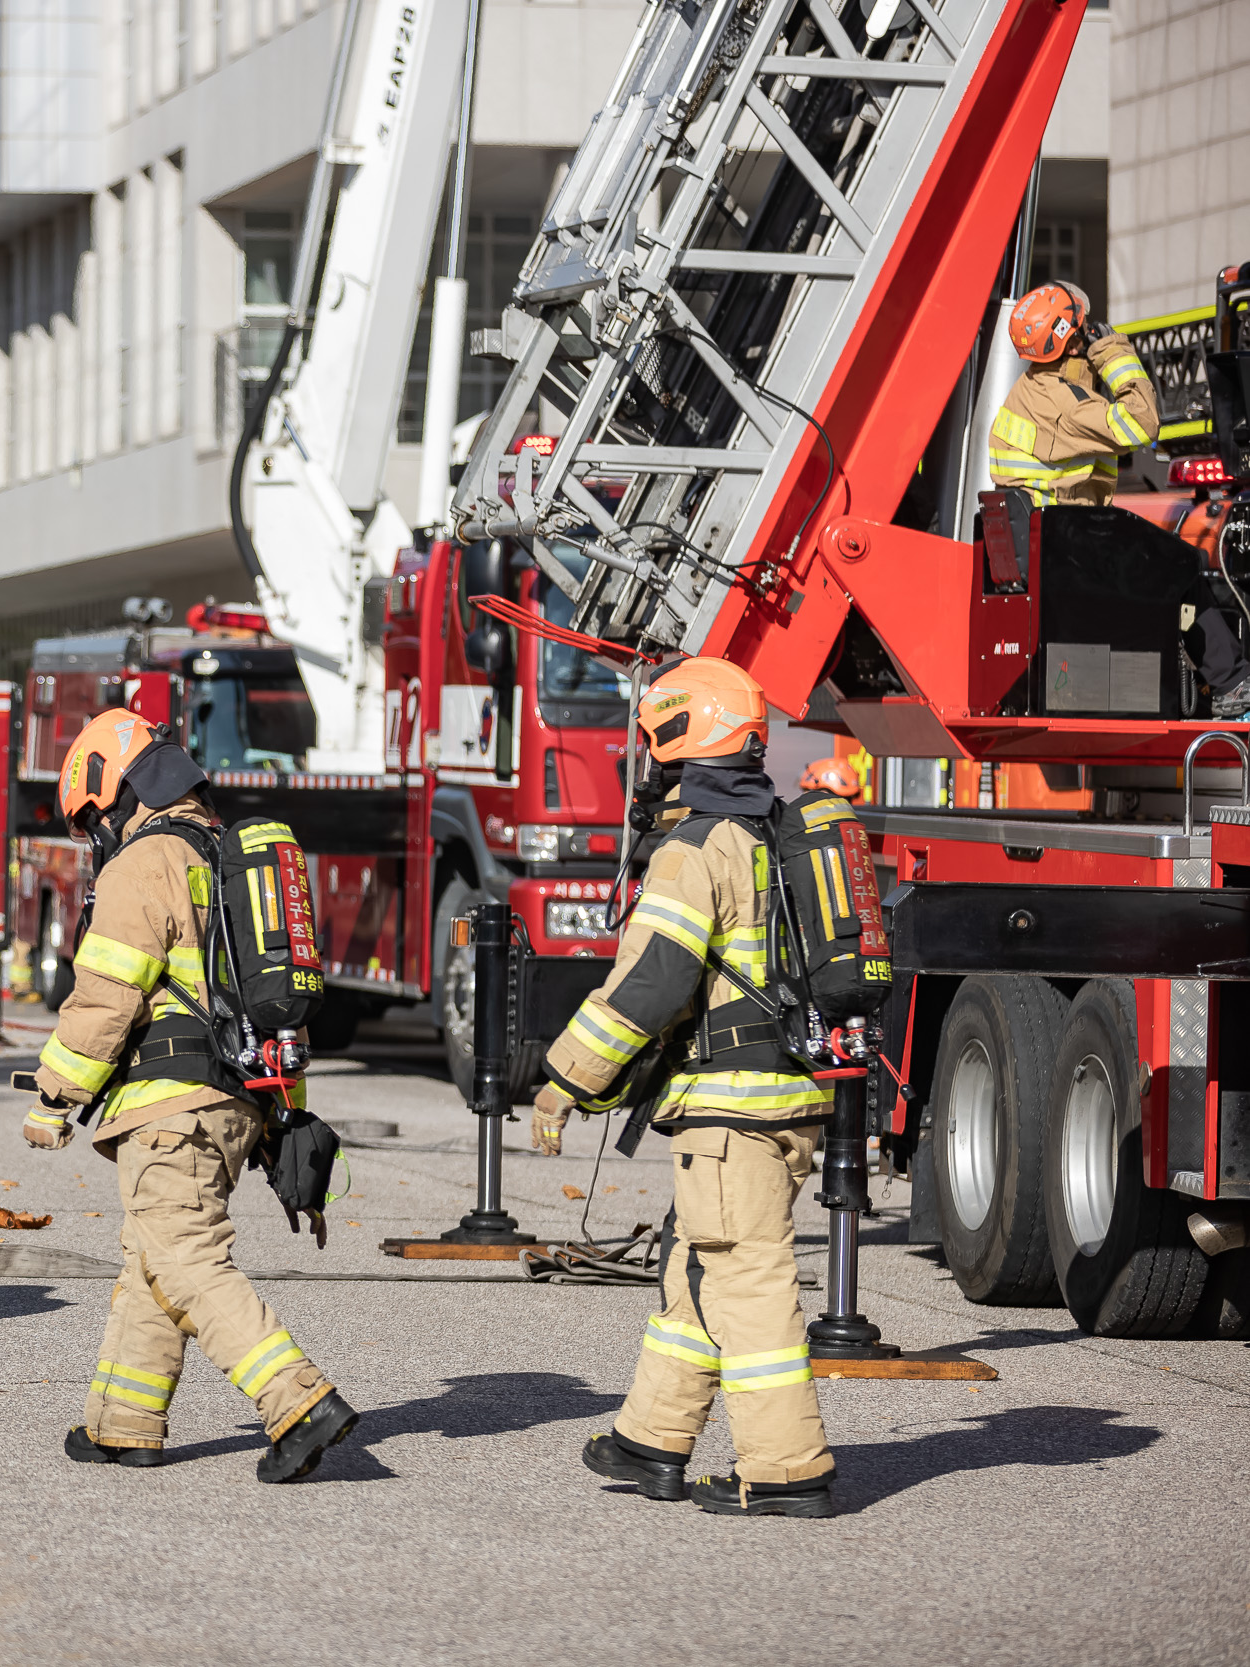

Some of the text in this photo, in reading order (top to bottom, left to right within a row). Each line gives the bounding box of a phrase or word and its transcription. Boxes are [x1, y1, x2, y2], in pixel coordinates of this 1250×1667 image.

[993, 639, 1020, 656] MORITA
[283, 849, 310, 961] 119구조대
[846, 828, 878, 949] 119구조대
